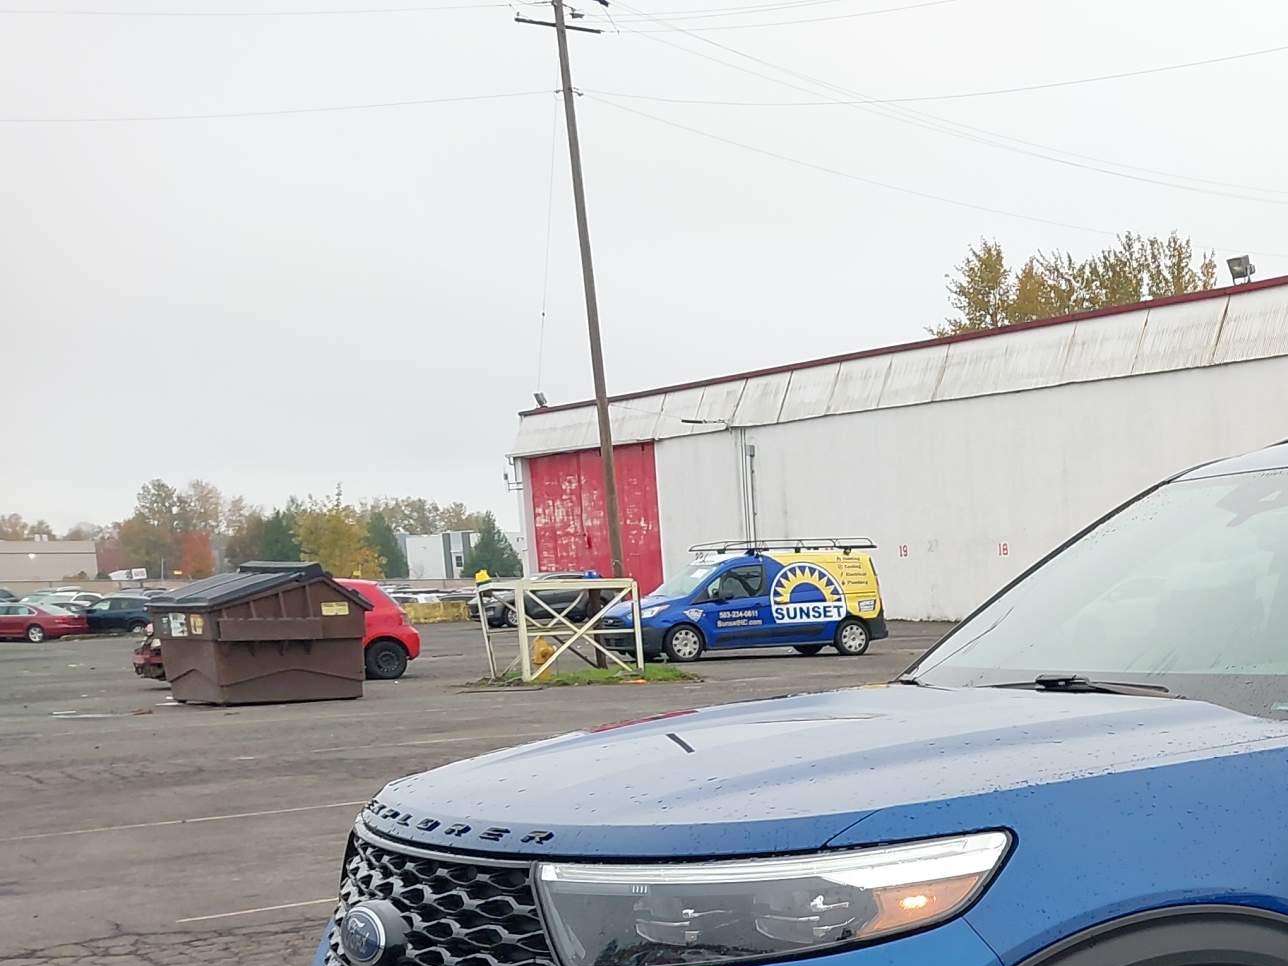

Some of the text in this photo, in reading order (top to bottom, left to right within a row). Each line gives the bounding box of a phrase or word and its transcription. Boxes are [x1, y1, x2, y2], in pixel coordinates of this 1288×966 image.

[899, 544, 908, 558] 19
[998, 543, 1009, 556] 18
[774, 605, 844, 621] SUNSET
